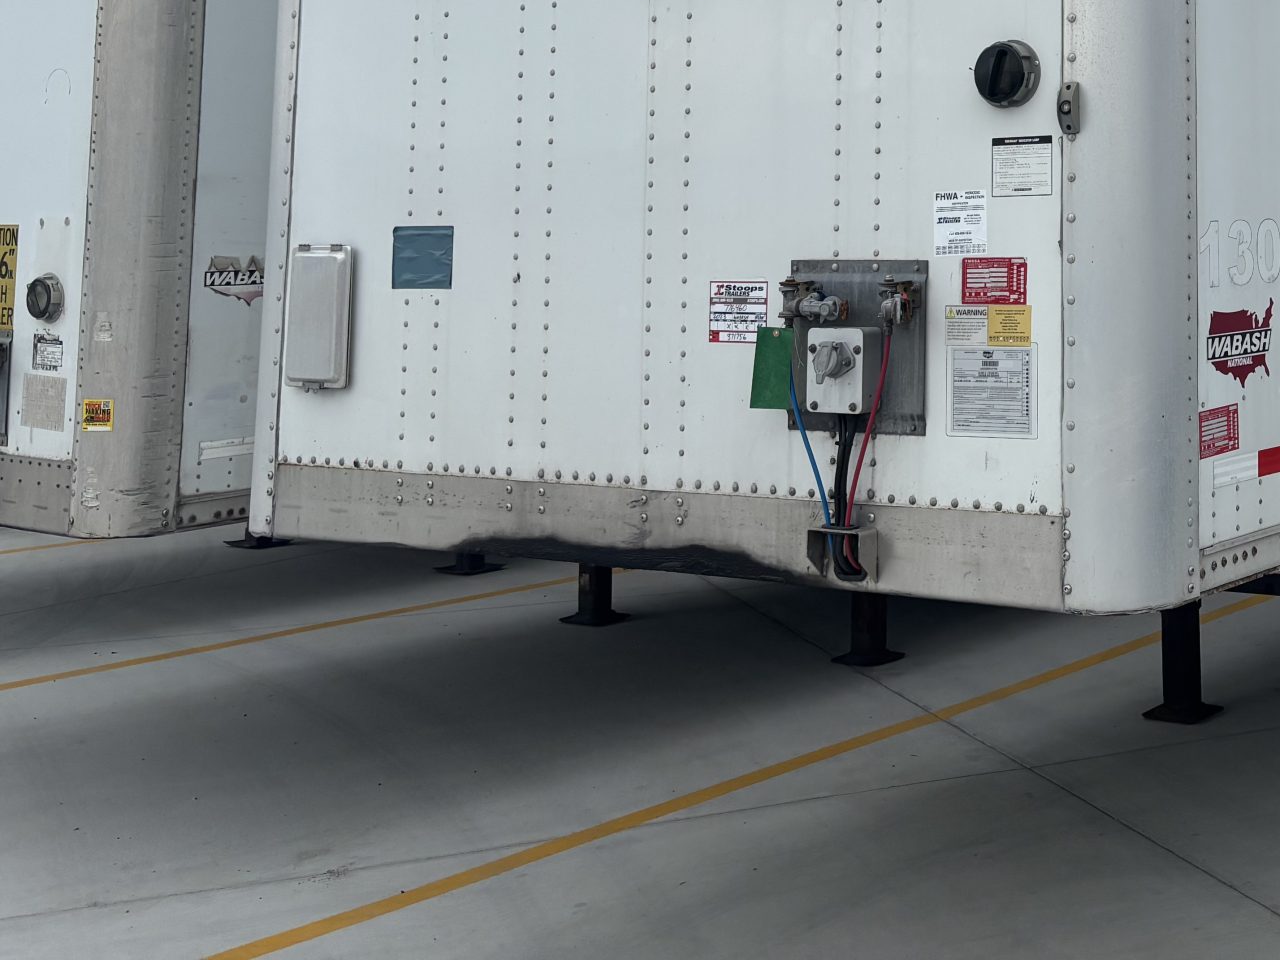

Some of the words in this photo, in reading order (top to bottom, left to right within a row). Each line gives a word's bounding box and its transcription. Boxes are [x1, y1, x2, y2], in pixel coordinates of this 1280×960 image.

[935, 192, 958, 201] FHWA
[205, 271, 264, 286] WABA
[724, 284, 764, 292] Stoops
[955, 309, 987, 317] WARNING
[1208, 331, 1271, 359] WABASH
[1227, 356, 1253, 368] NATIONAL
